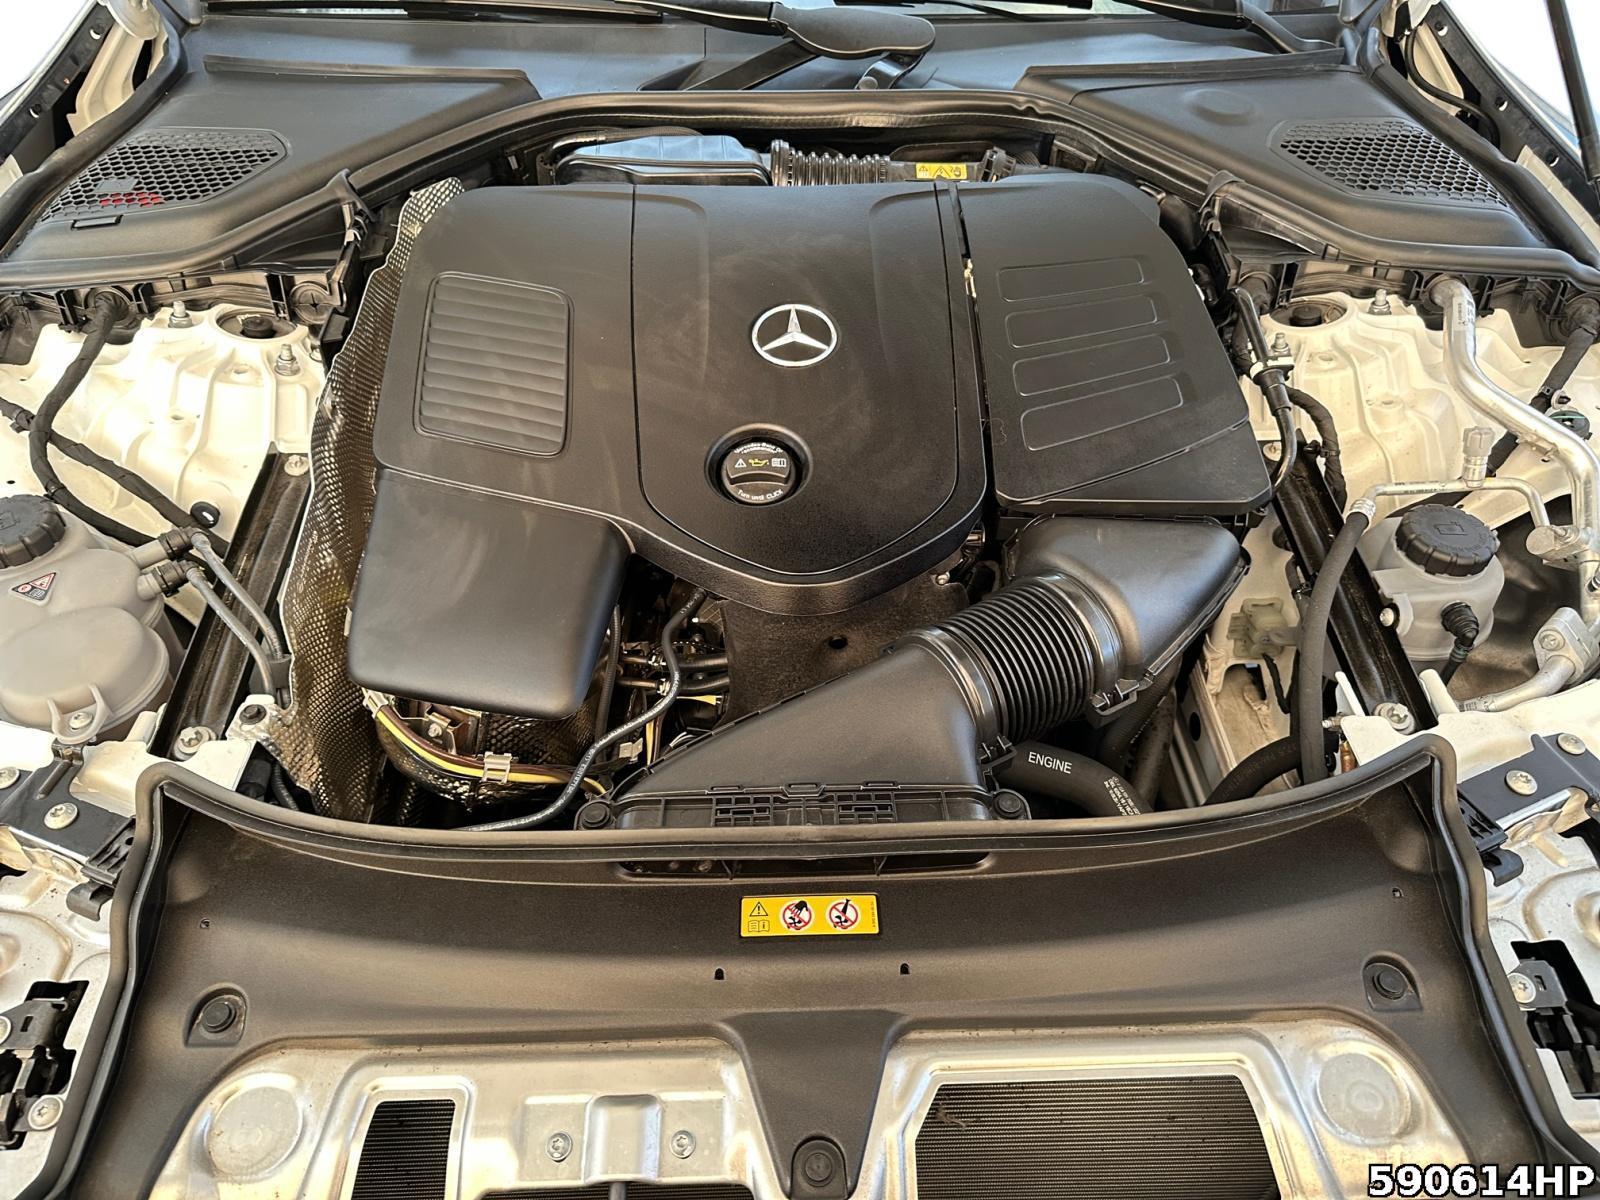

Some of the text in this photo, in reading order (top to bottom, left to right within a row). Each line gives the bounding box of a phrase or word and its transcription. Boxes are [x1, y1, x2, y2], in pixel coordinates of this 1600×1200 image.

[738, 489, 750, 499] Turn
[766, 488, 784, 499] CLICK
[1028, 751, 1073, 774] ENGINE
